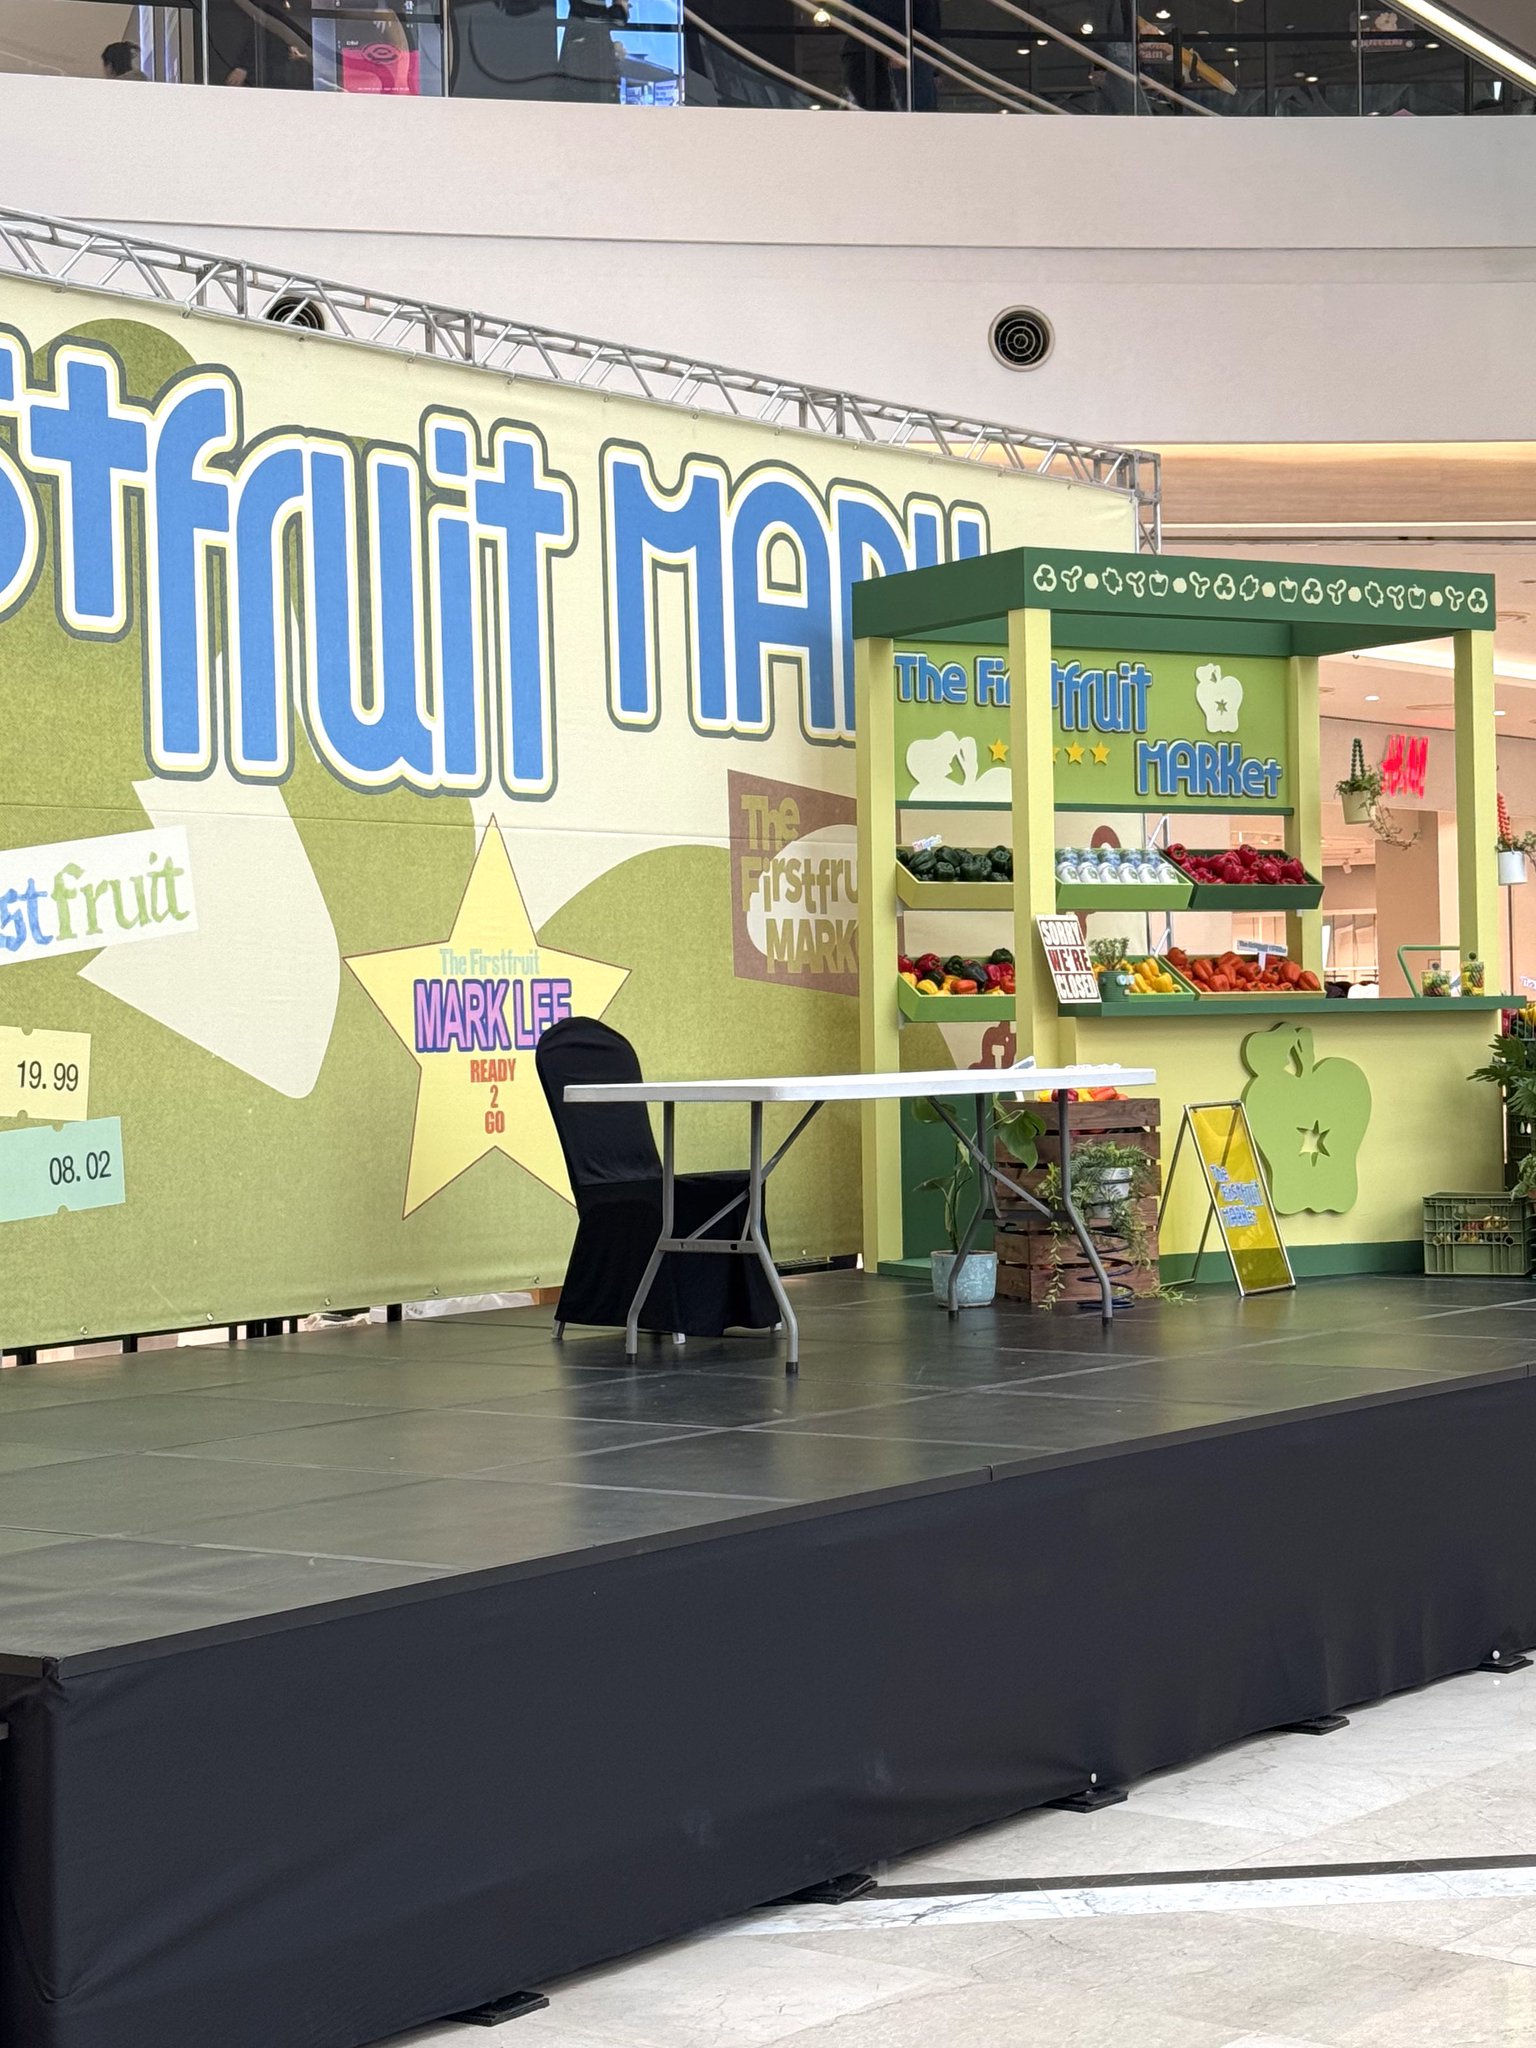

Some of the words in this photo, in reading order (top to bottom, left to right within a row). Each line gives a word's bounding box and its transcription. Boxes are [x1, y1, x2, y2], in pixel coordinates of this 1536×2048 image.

[603, 445, 987, 745] MA
[894, 652, 968, 706] The
[1135, 739, 1283, 798] MARKet
[741, 794, 800, 851] The
[1039, 920, 1083, 946] SORRY
[441, 948, 468, 976] The
[469, 948, 541, 976] Firstfruit
[1047, 947, 1092, 972] WE'RE
[1055, 973, 1099, 998] CLOSED
[413, 978, 512, 1052] MARK
[17, 1060, 79, 1091] 19.99
[470, 1059, 517, 1083] READY
[489, 1084, 499, 1108] 2
[484, 1110, 505, 1134] GO
[49, 1150, 112, 1185] 08.02
